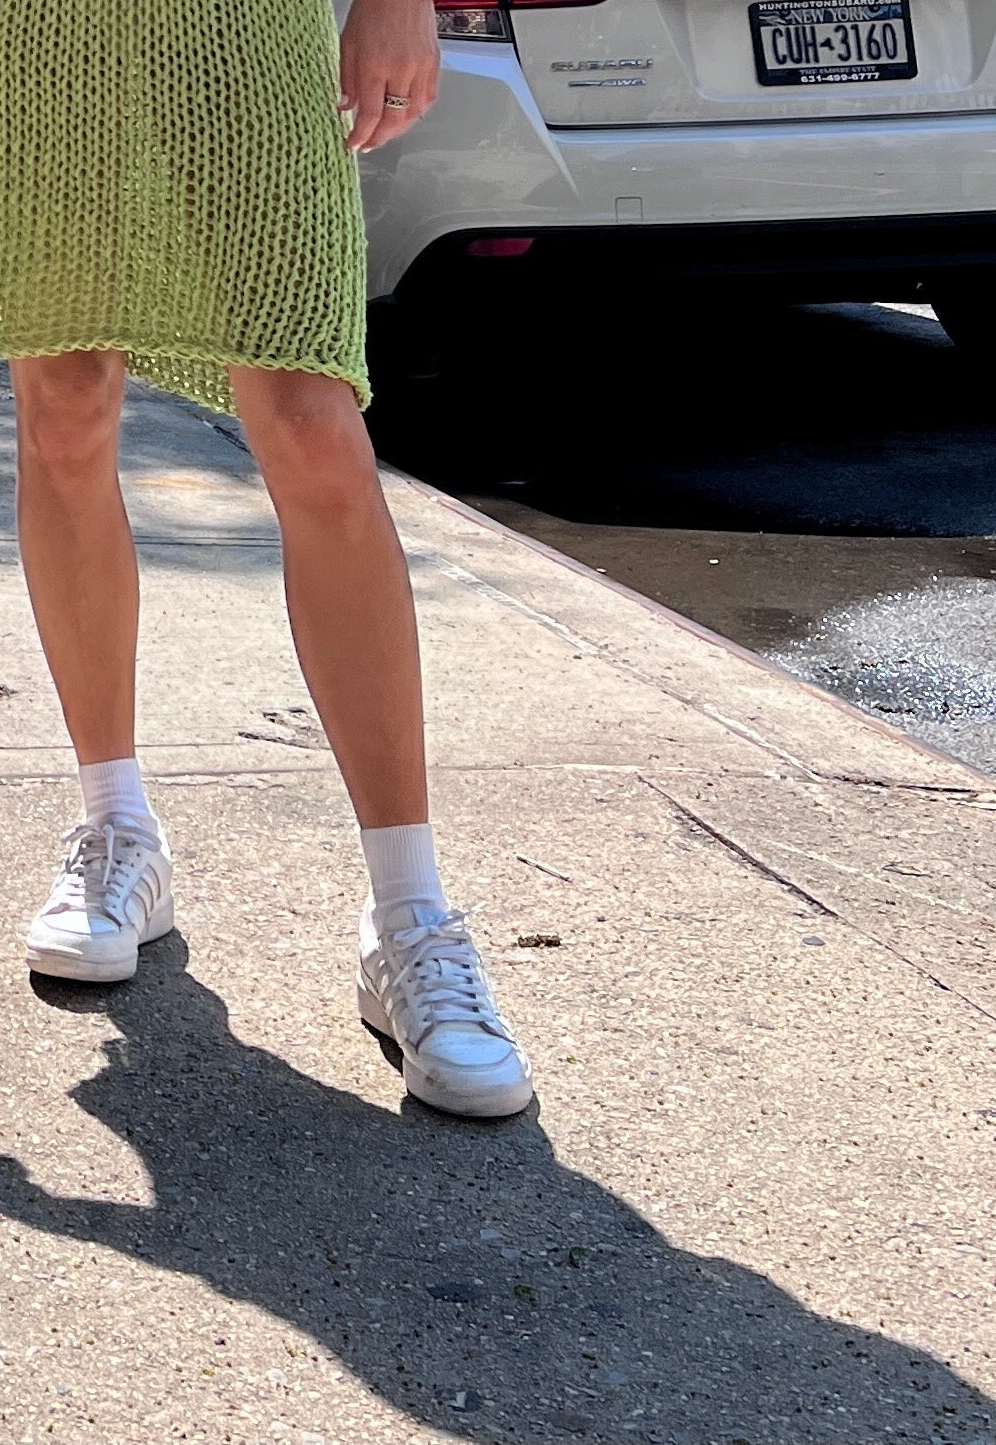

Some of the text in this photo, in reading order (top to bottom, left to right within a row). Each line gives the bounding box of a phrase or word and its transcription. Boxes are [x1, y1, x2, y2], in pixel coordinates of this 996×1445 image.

[791, 6, 870, 25] NEW YORK
[550, 59, 653, 72] SUBARU
